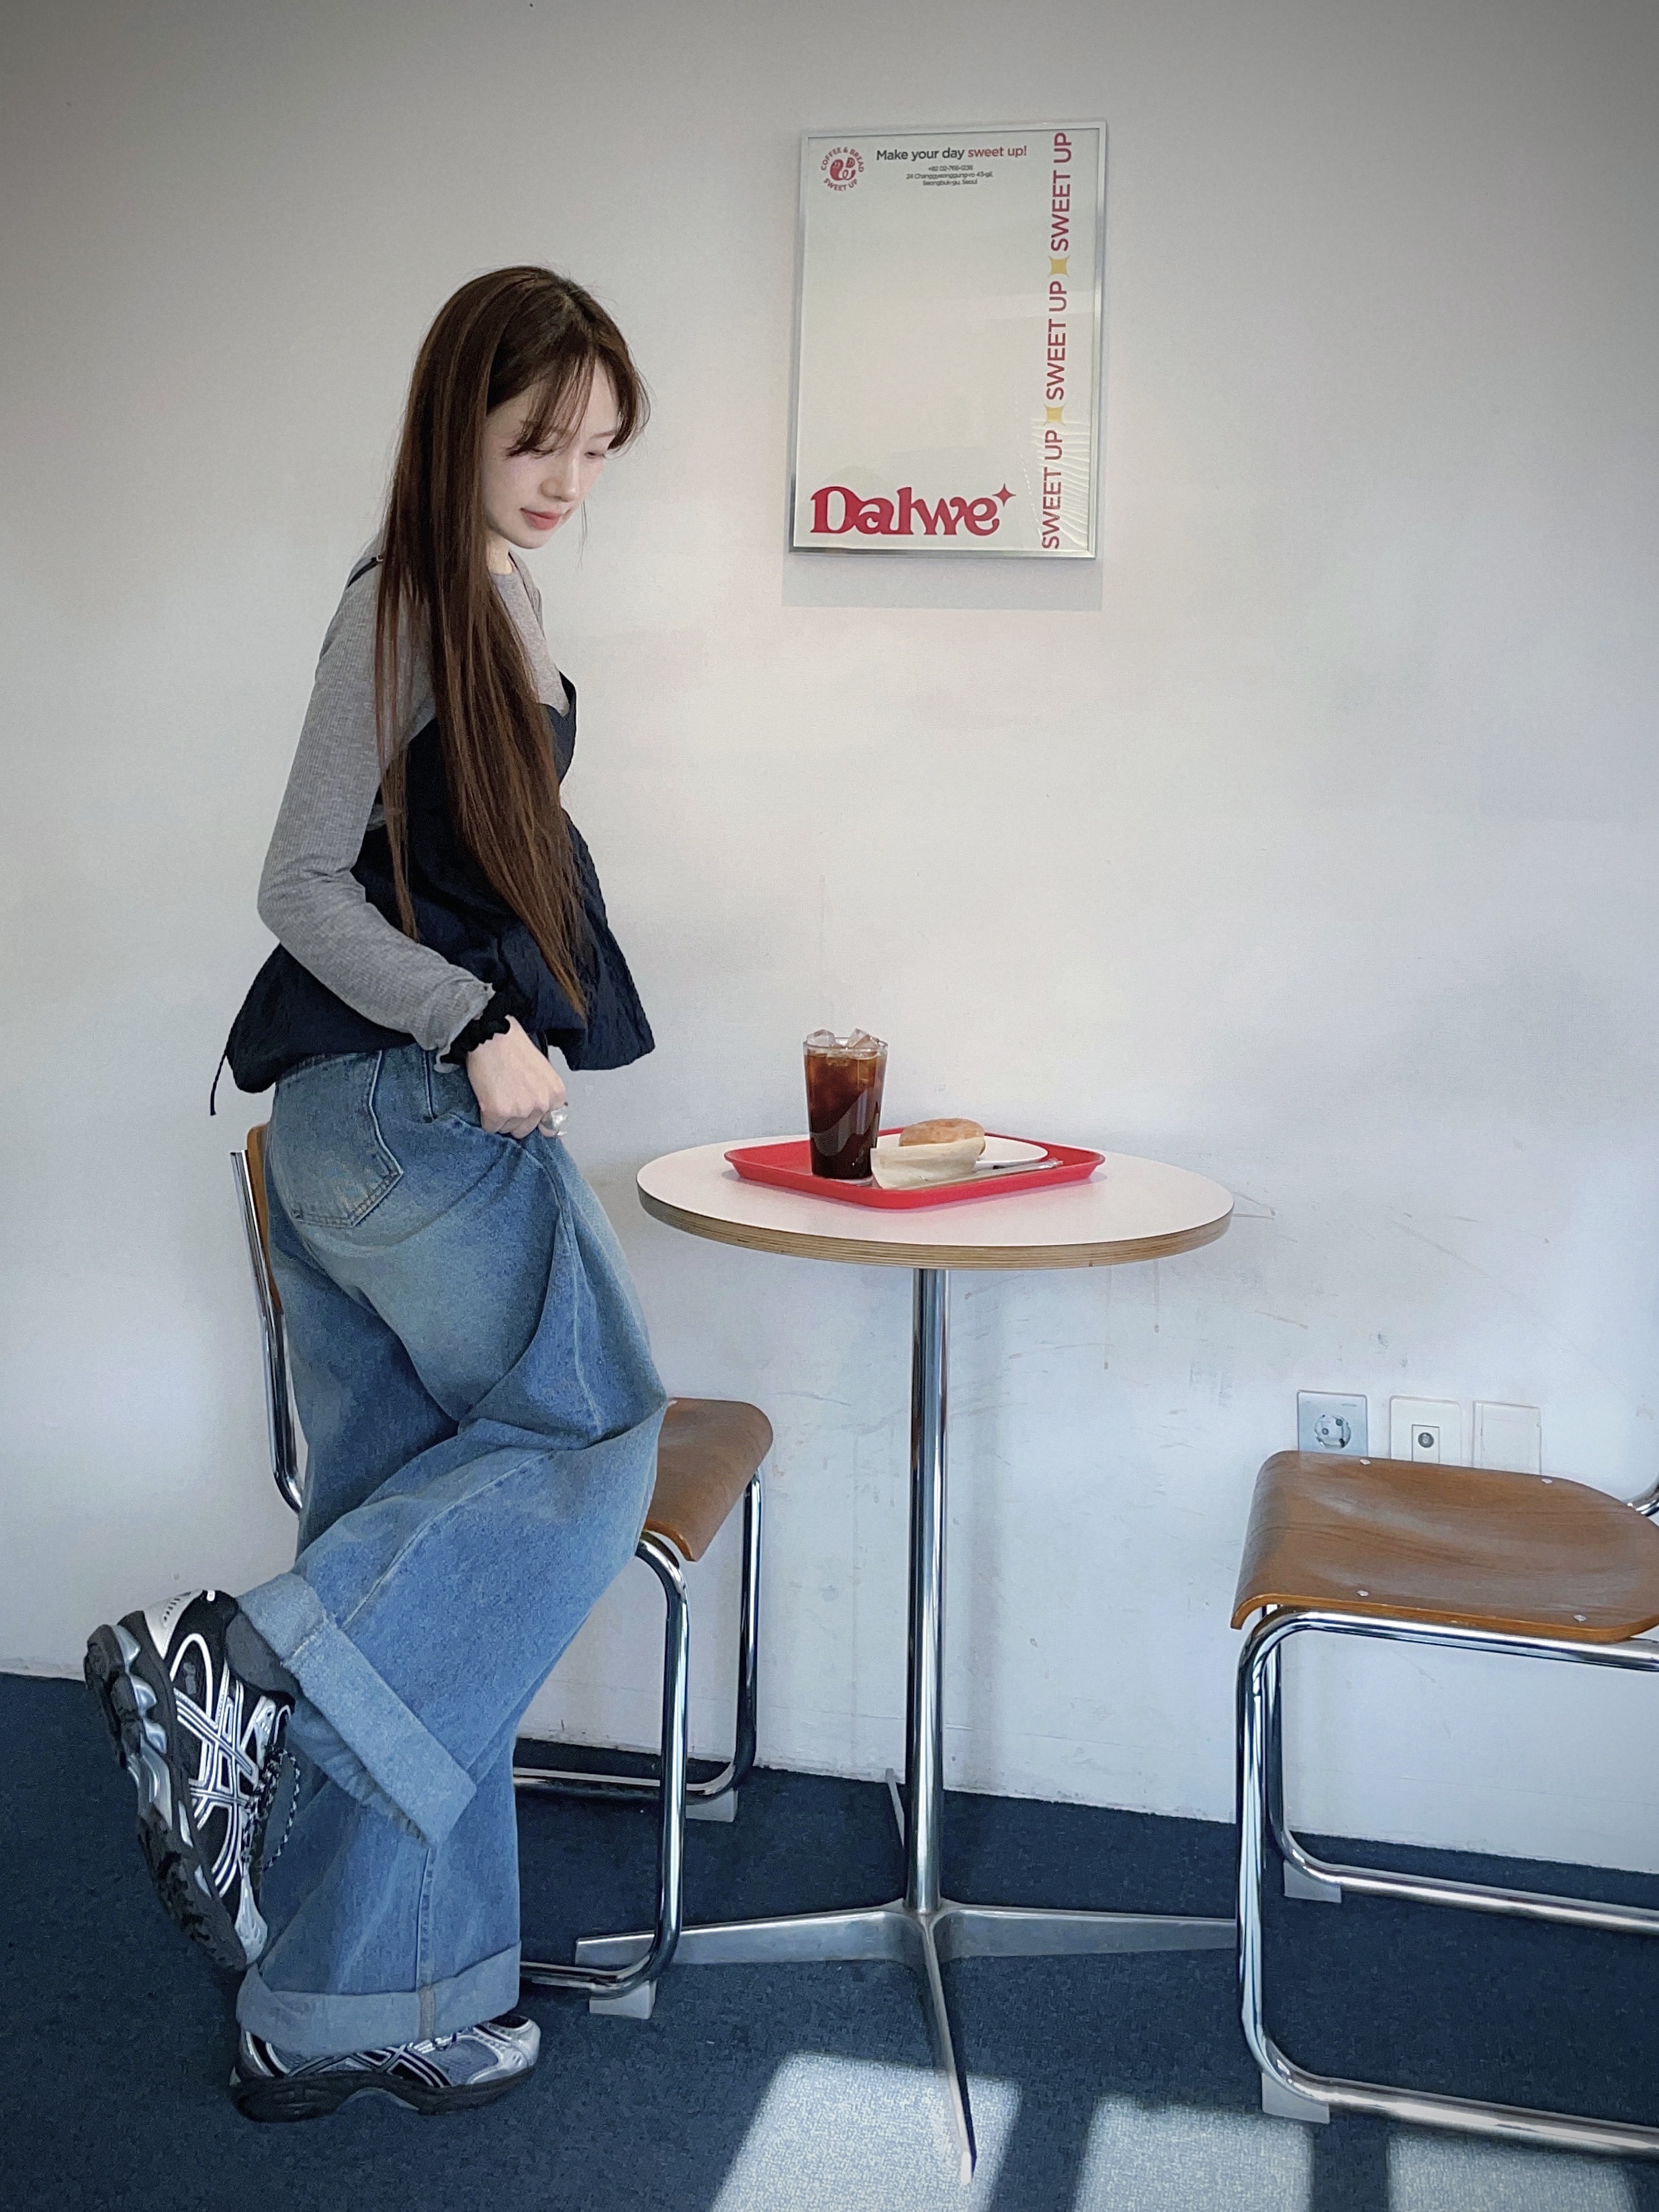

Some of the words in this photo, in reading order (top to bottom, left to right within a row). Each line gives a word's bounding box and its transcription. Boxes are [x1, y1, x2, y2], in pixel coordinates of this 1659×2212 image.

[821, 147, 842, 171] COFFEE
[849, 148, 864, 172] BREAD
[877, 149, 908, 161] Make
[911, 150, 940, 161] your
[942, 147, 965, 160] day
[968, 146, 1004, 158] sweet
[1007, 145, 1027, 158] up!
[1053, 132, 1073, 164] UP
[823, 178, 847, 191] SWEET
[848, 179, 858, 189] UP
[1050, 169, 1071, 252] SWEET
[1048, 281, 1068, 312] UP
[1046, 318, 1067, 401] SWEET
[1044, 429, 1063, 461] UP
[810, 486, 1000, 536] Dalwe
[1041, 467, 1062, 549] SWEET
